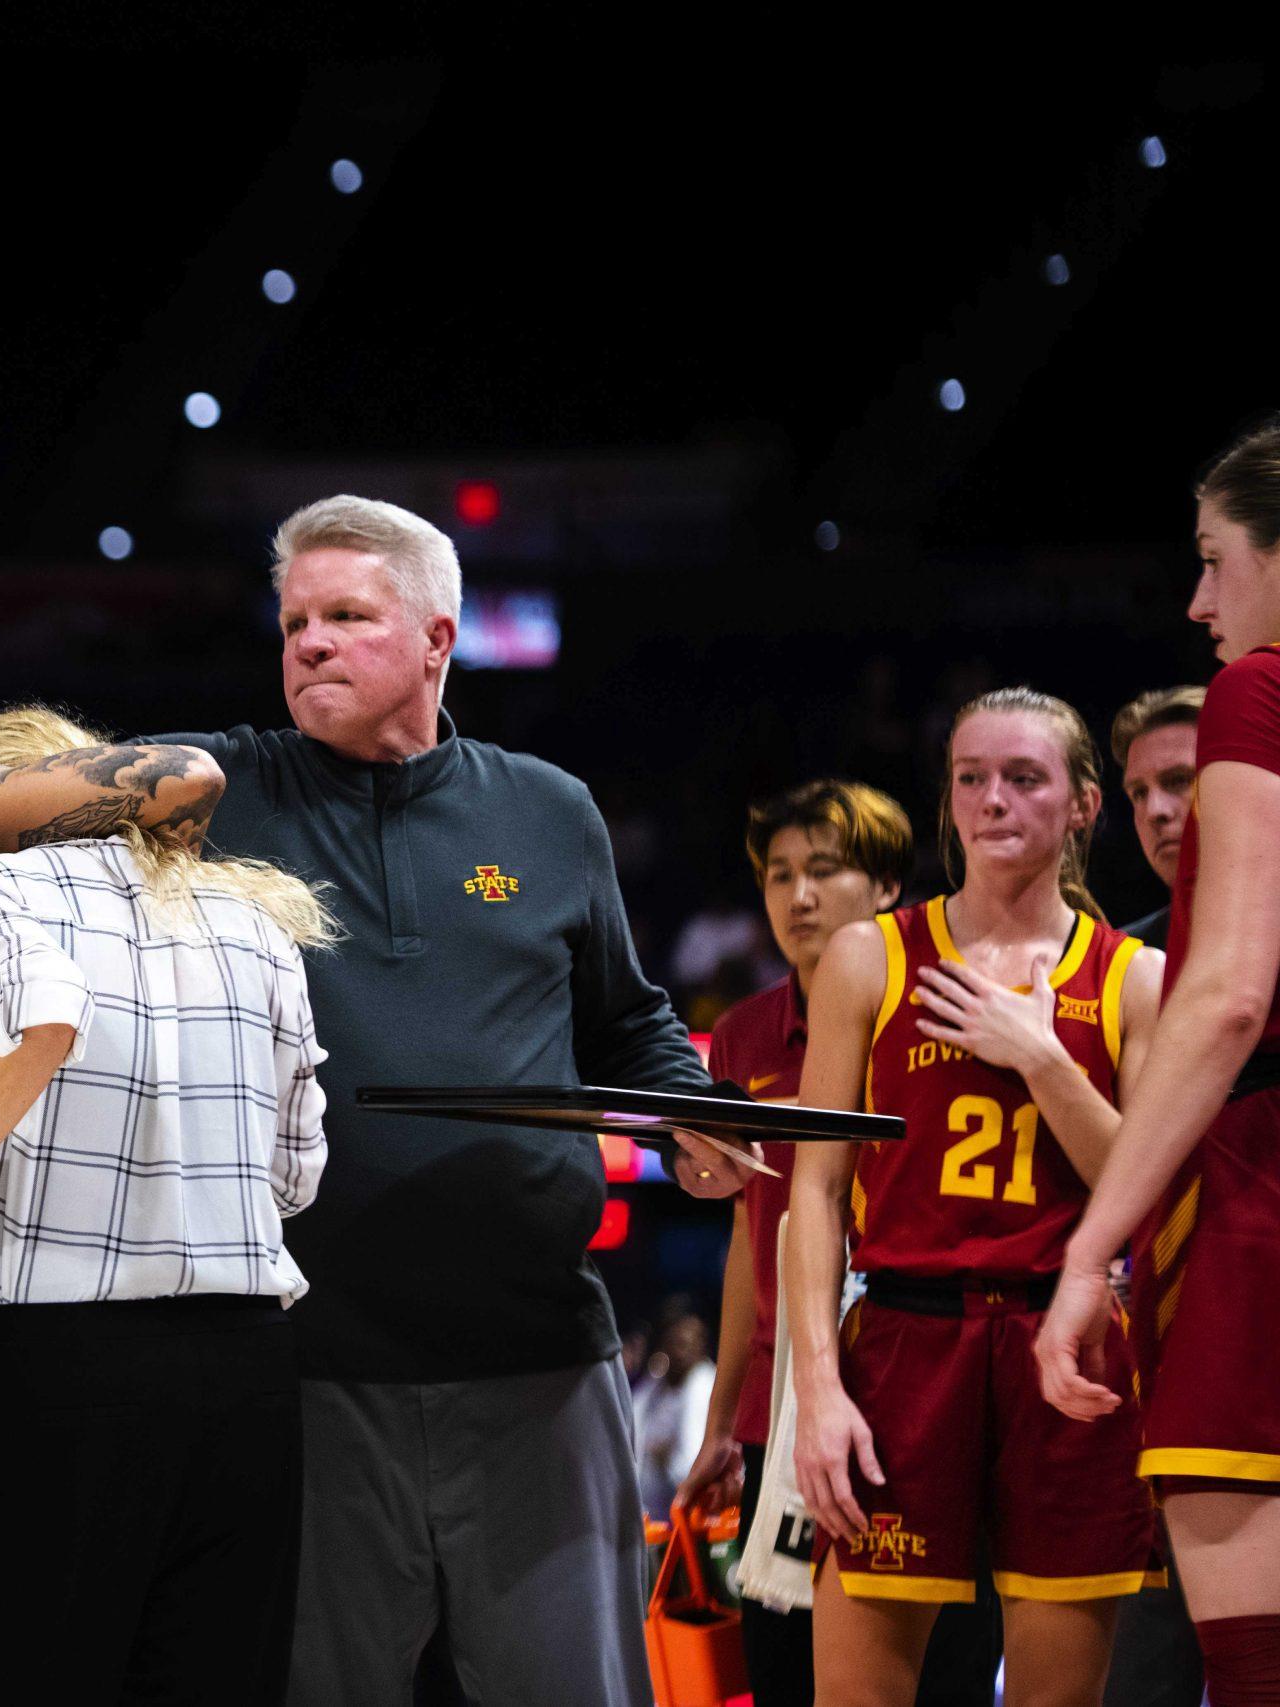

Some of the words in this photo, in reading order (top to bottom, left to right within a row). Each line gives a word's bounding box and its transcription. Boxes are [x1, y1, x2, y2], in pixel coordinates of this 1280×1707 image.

[463, 875, 519, 895] STATE
[907, 1040, 974, 1073] IOW
[939, 1094, 1038, 1206] 21
[850, 1530, 926, 1557] STATE
